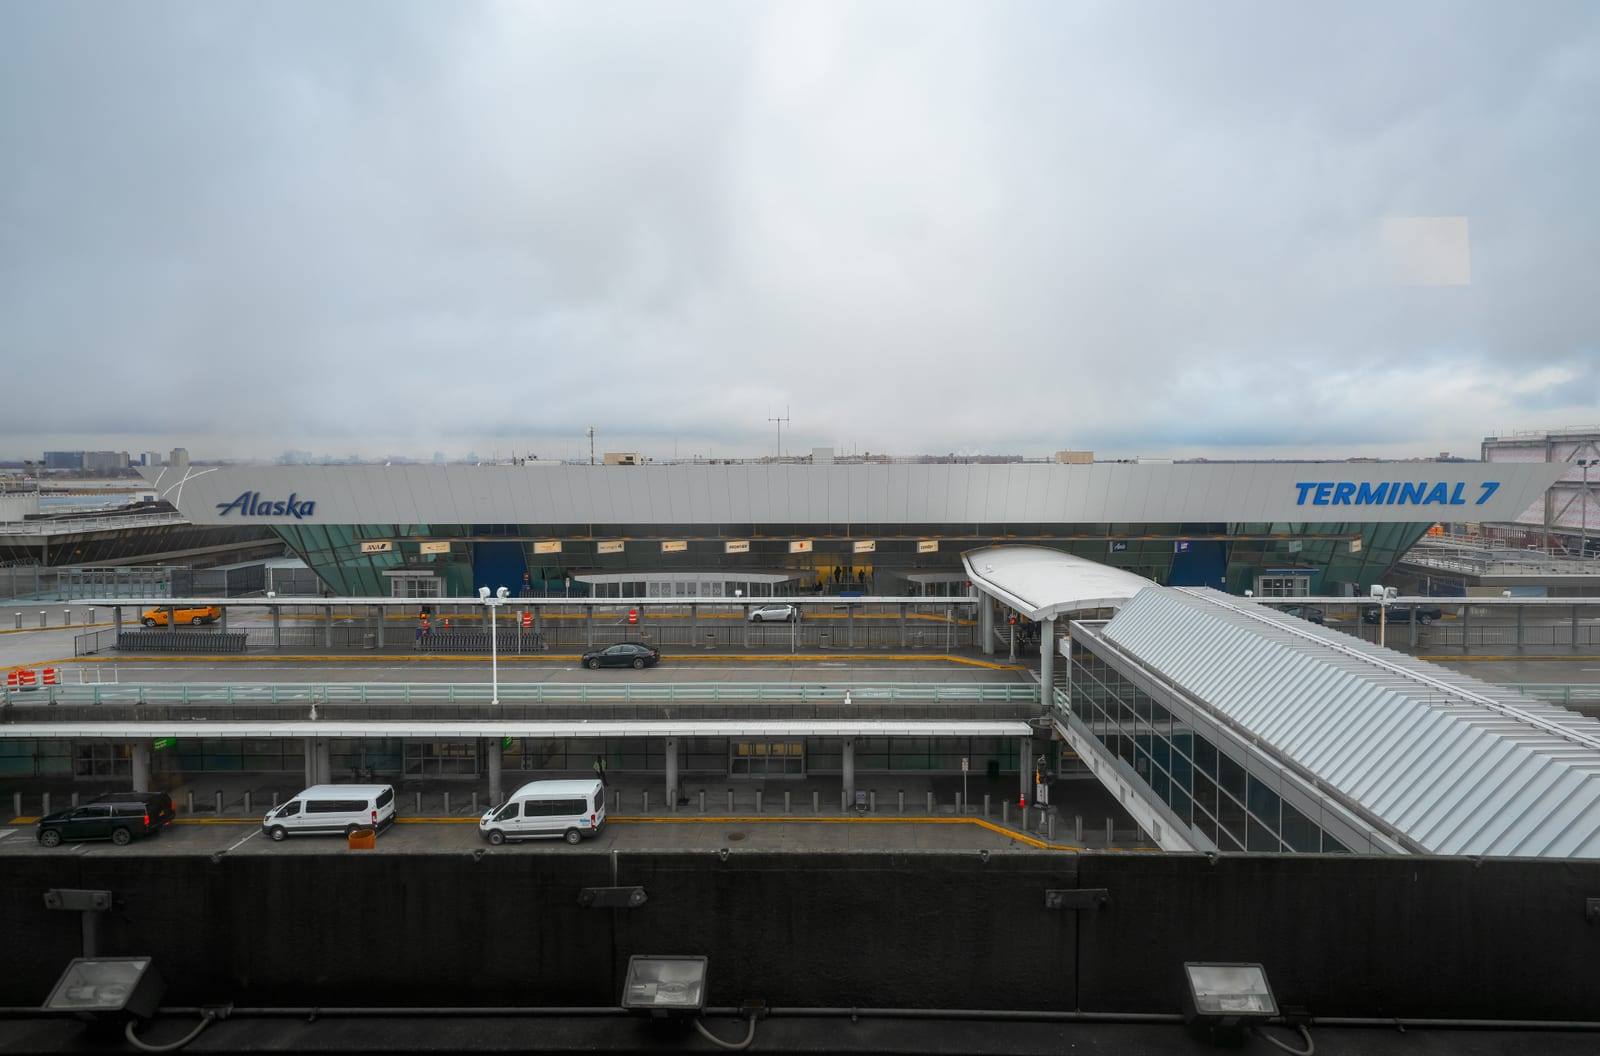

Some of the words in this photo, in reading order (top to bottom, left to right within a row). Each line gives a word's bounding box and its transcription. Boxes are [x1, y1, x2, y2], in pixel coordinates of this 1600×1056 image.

[216, 490, 316, 519] Alaska
[1296, 482, 1466, 506] TERMINAL
[1475, 482, 1500, 505] 7
